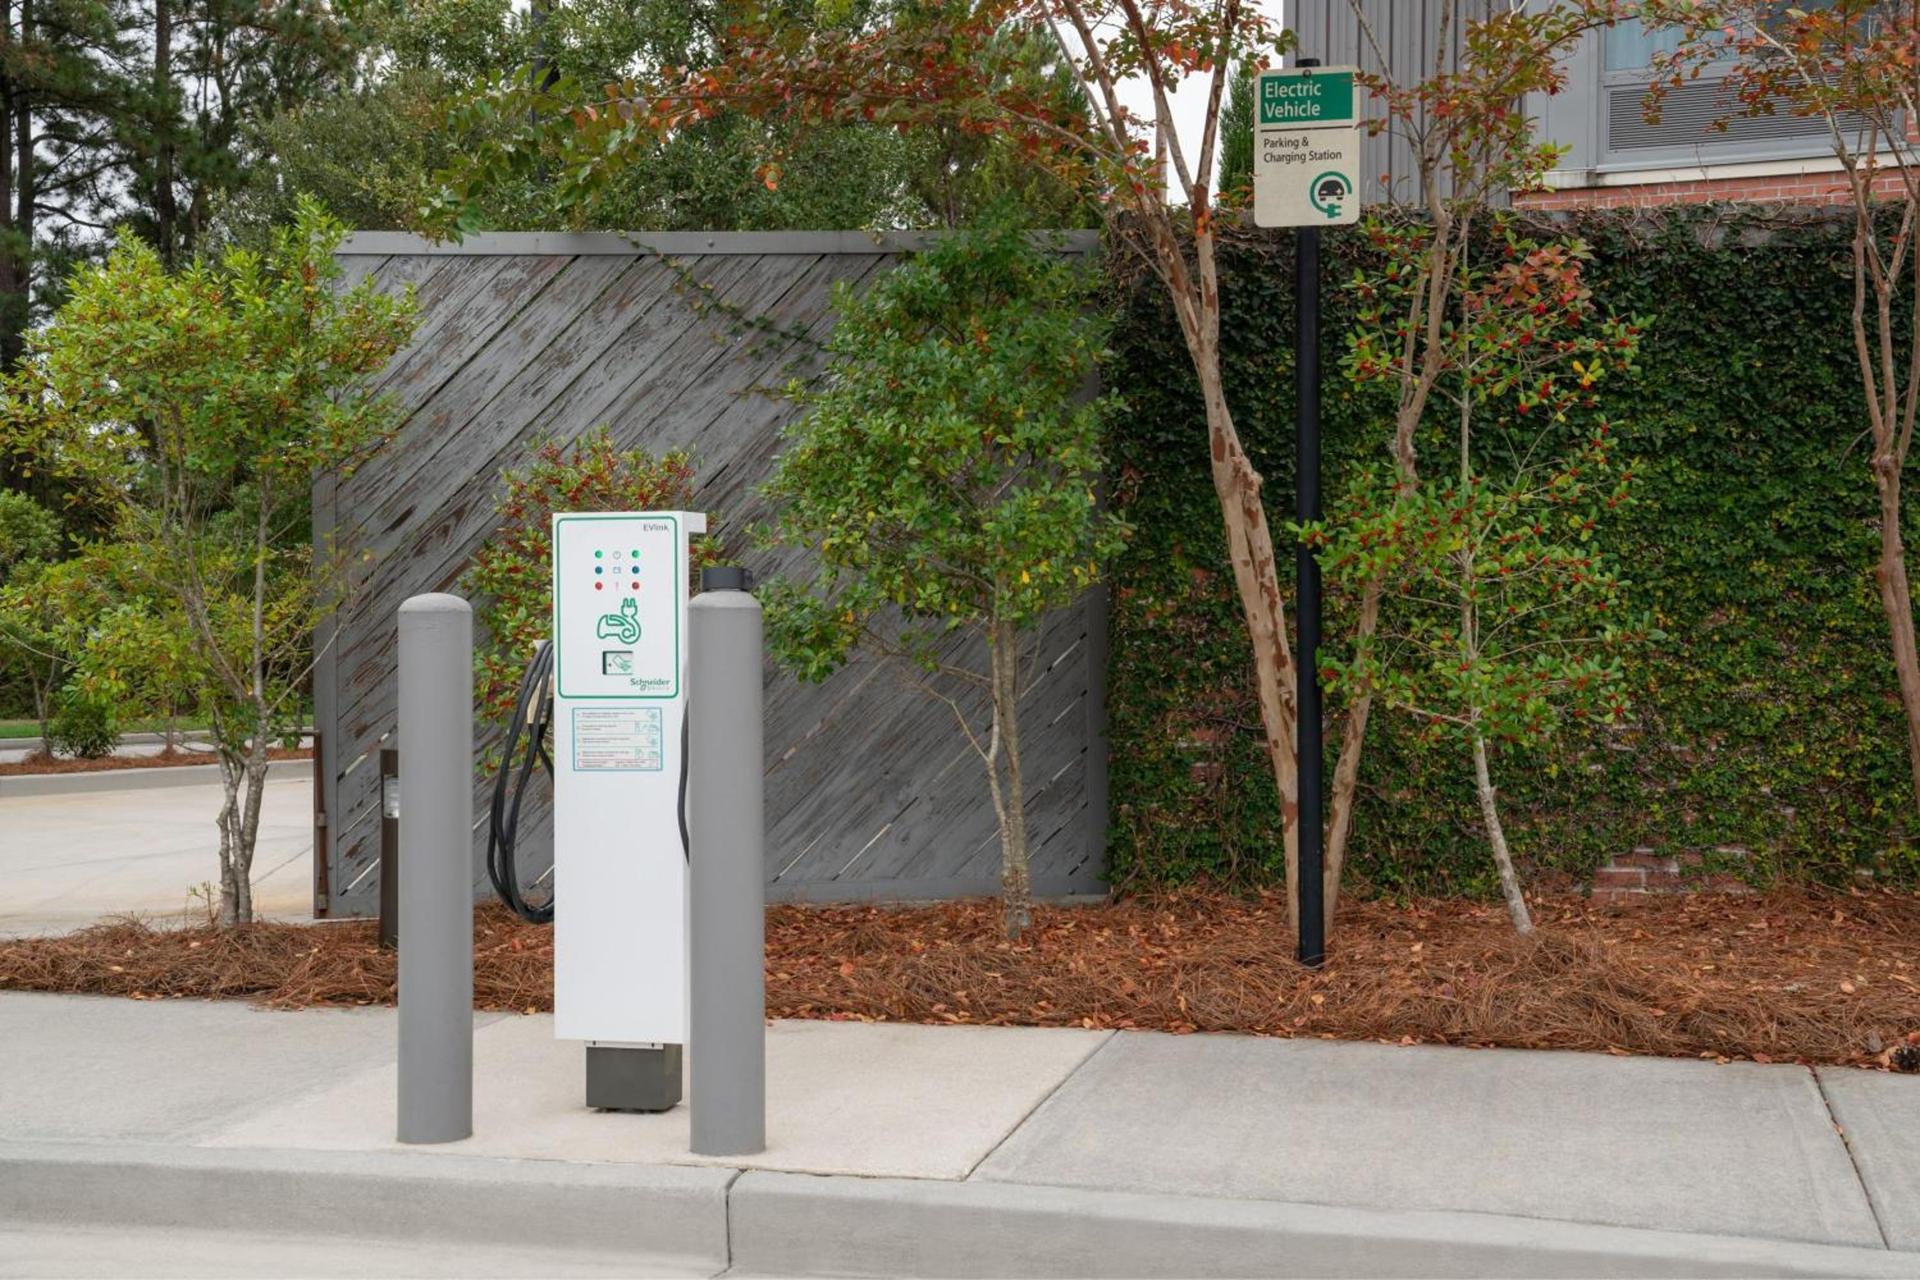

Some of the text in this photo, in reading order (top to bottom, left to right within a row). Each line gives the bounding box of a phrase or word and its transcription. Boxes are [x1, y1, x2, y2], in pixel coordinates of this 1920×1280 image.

[1264, 80, 1322, 98] Electric
[1264, 100, 1321, 118] Vehicle
[1263, 137, 1309, 149] Parking &
[1263, 149, 1342, 164] Charging Station
[643, 523, 669, 532] EVlink
[630, 677, 671, 686] Schneider
